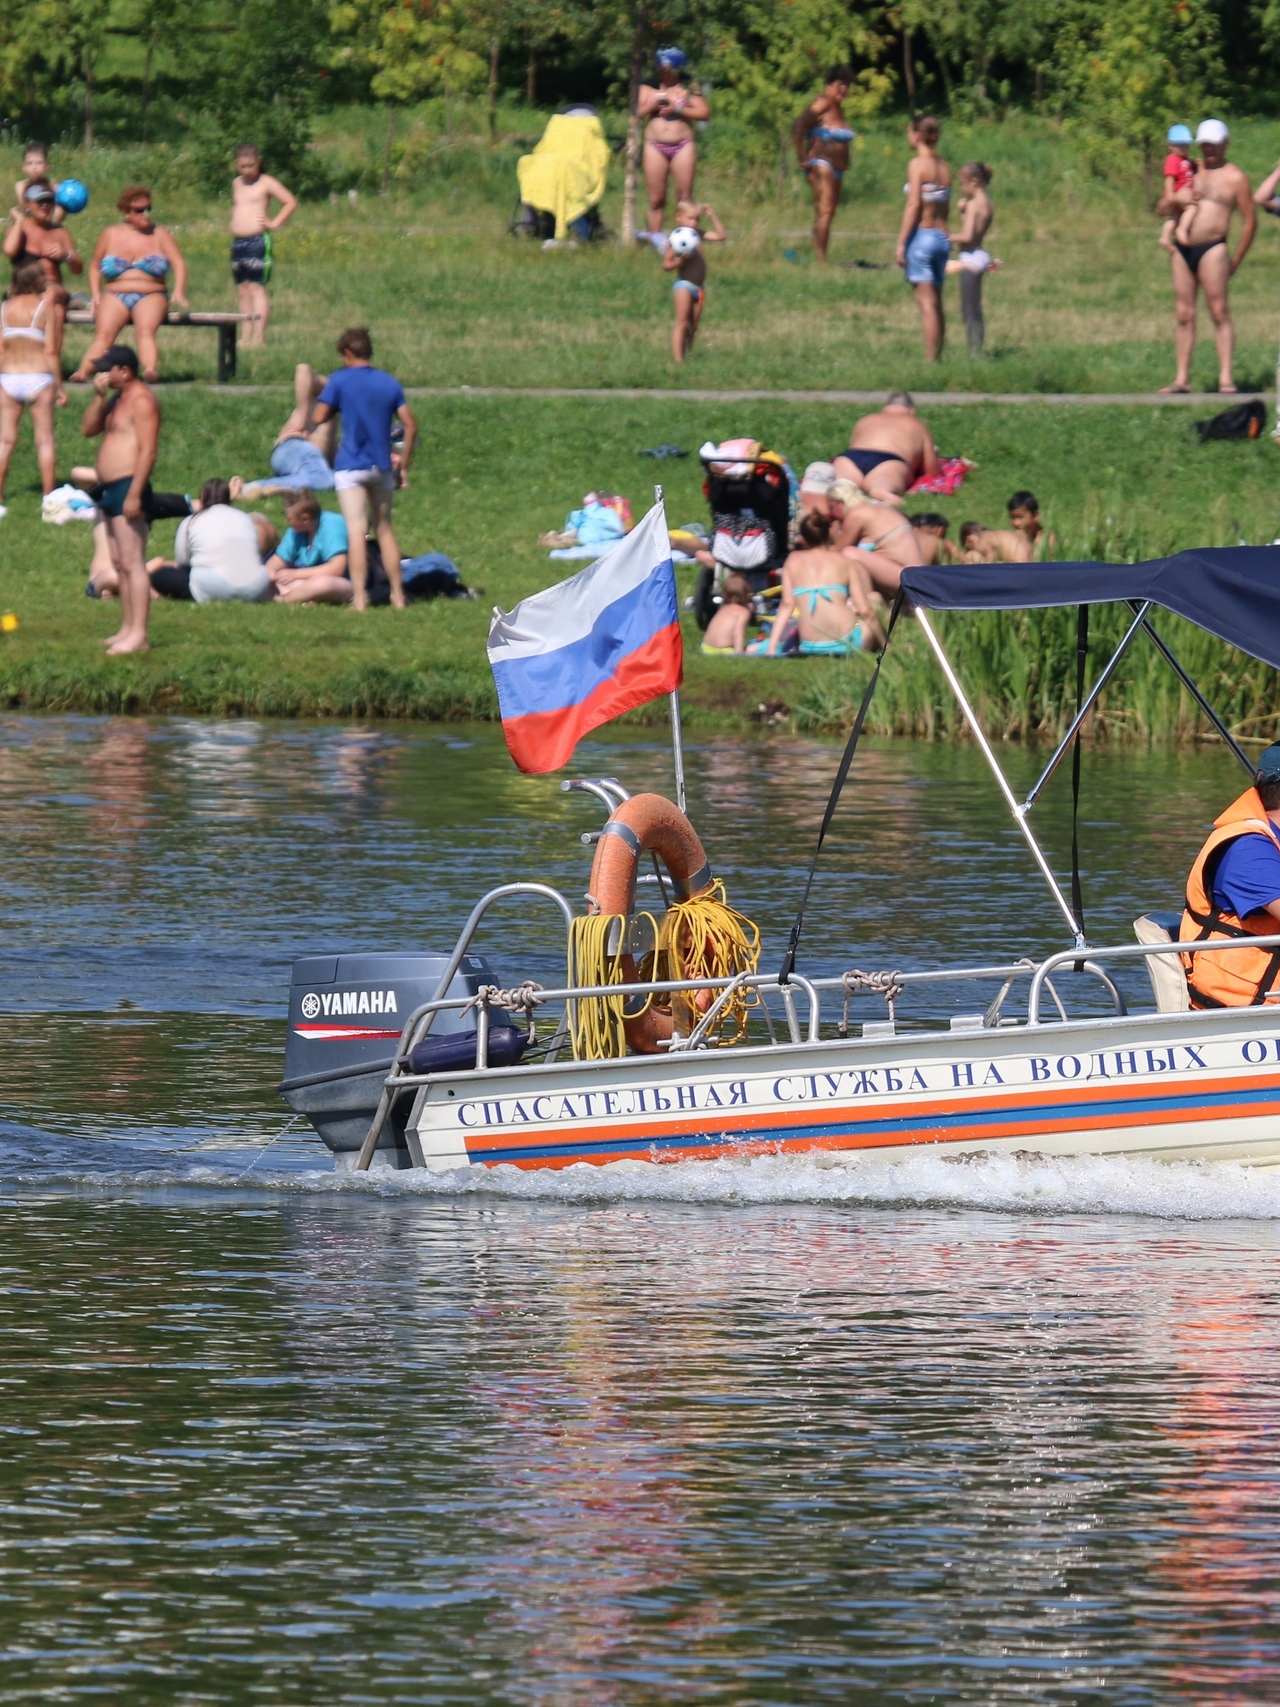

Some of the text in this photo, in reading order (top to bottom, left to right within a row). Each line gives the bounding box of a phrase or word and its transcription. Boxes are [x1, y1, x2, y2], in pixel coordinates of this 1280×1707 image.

[320, 990, 398, 1016] YAMAHA
[457, 1081, 748, 1126] СПАСАТЕЛЬНАЯ
[773, 1067, 929, 1101] СЛУЖБА
[951, 1062, 1005, 1087] НА
[1029, 1045, 1208, 1082] ВОДНЫХ
